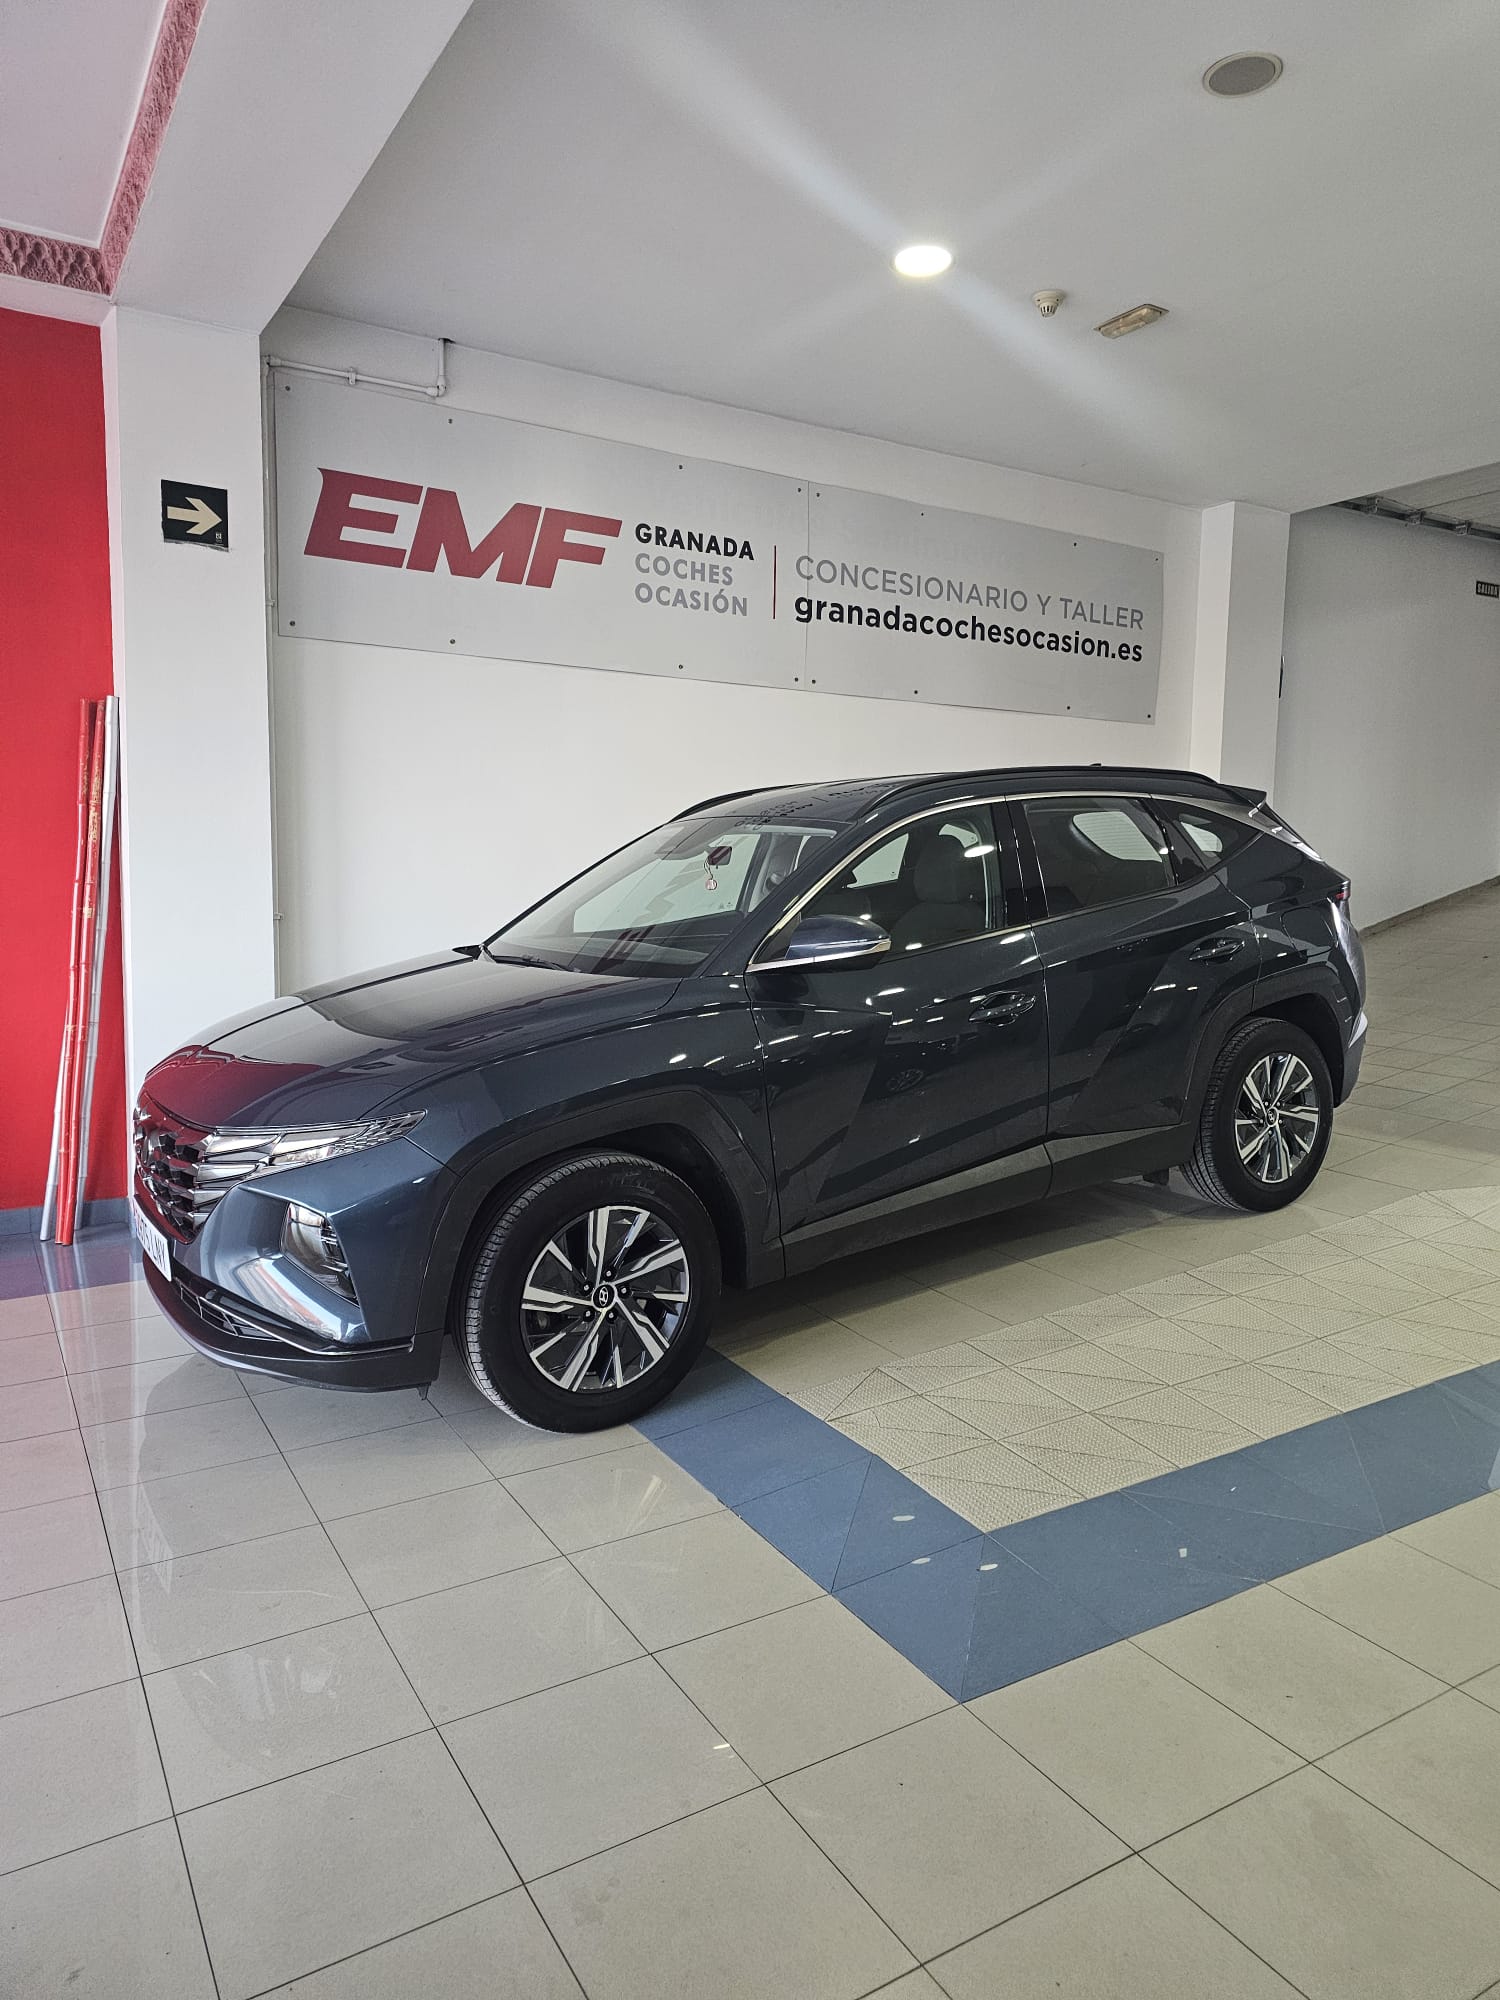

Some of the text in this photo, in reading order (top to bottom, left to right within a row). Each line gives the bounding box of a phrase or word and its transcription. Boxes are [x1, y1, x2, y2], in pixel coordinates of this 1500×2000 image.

[304, 467, 622, 588] EMF
[635, 523, 755, 561] GRANADA
[634, 553, 734, 586] COCHES
[795, 555, 1144, 630] CONCESIONARIO Y TALLER
[634, 582, 748, 617] OCASIÓN
[794, 596, 1143, 662] granadacochesocasion.es
